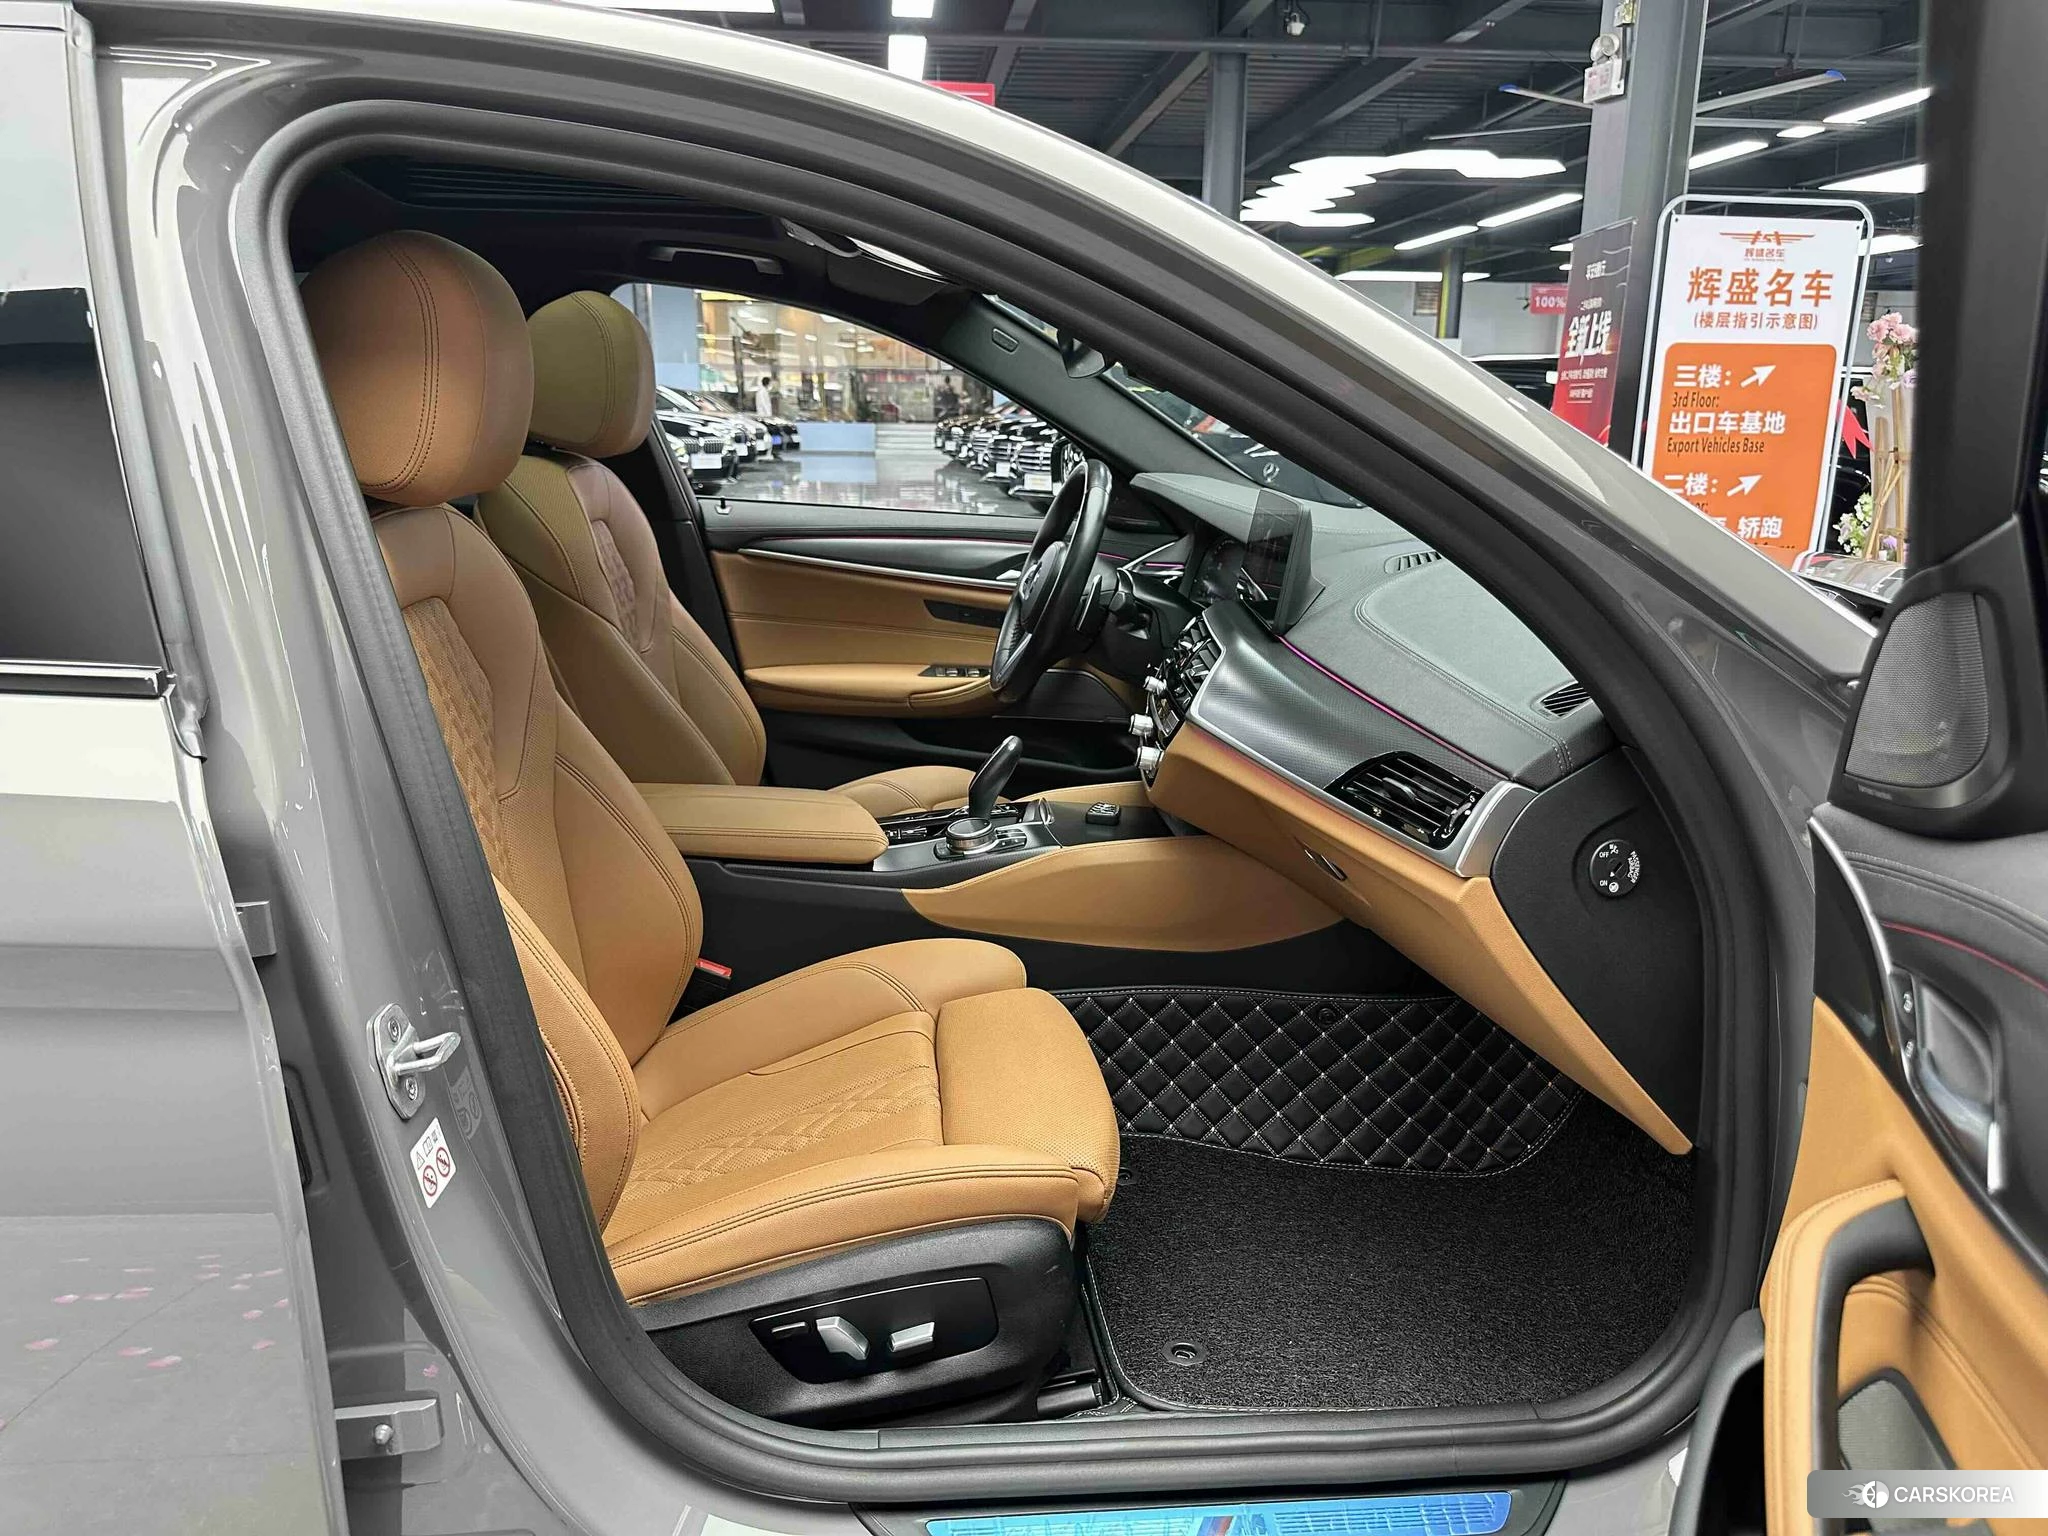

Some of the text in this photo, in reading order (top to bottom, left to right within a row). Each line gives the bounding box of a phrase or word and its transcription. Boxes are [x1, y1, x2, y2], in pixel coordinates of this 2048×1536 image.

[1686, 266, 1834, 308] 辉盛名车
[1693, 309, 1818, 331] (楼层指引示意图)
[1672, 391, 1720, 408] 3rd Floor:
[1669, 410, 1787, 435] 出口车基地
[1667, 437, 1765, 457] Export Vehicles Base
